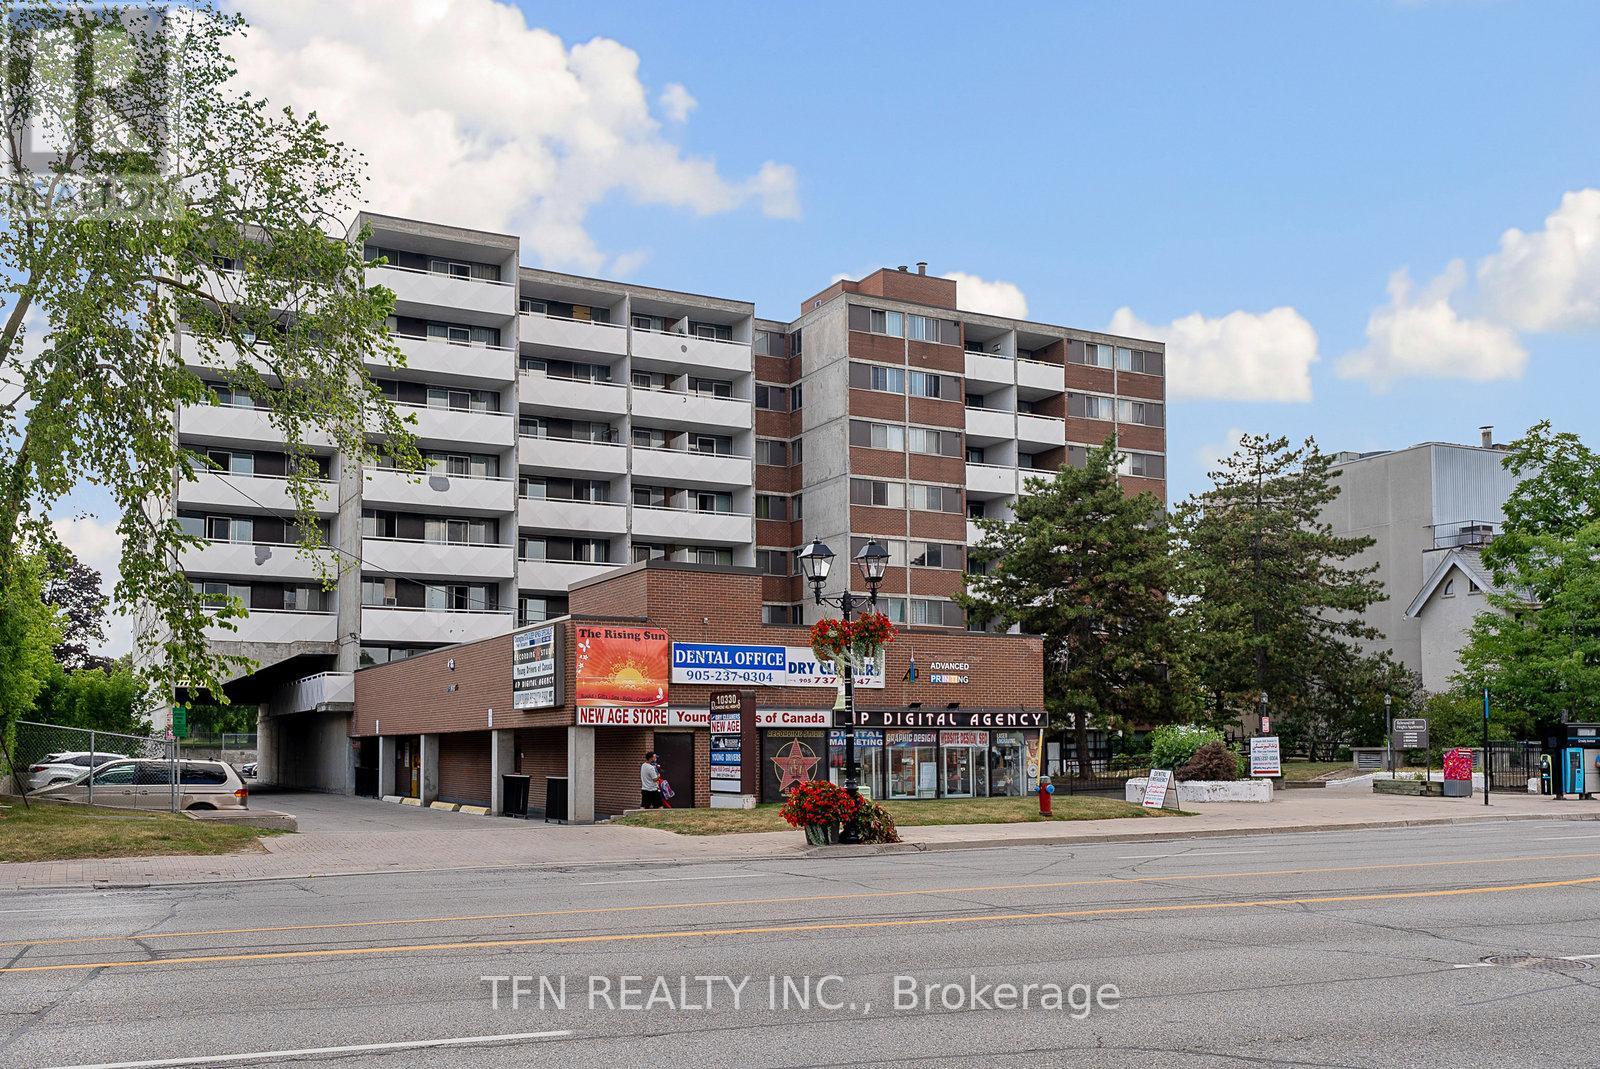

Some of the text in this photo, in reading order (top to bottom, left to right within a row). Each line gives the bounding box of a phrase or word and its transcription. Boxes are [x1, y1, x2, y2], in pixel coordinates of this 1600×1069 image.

[579, 628, 666, 642] The Rising Sun
[675, 649, 784, 667] DENTAL OFFICE
[788, 661, 815, 675] DRY
[930, 662, 970, 670] ADVANCED
[686, 670, 774, 683] 905-237-0304
[813, 677, 837, 685] 737
[930, 674, 969, 684] PRINTING
[716, 694, 737, 705] 10330
[580, 707, 667, 725] NEW AGE STORE
[676, 711, 711, 725] Young
[765, 712, 778, 723] of
[781, 712, 825, 723] Canada
[884, 712, 957, 726] DIGITAL
[970, 713, 1042, 726] AGENCY
[711, 720, 740, 733] NEW AGE
[830, 730, 883, 738] DIITAL
[886, 732, 937, 744] GRAPHIC DESIGN
[829, 738, 883, 746] MAETING
